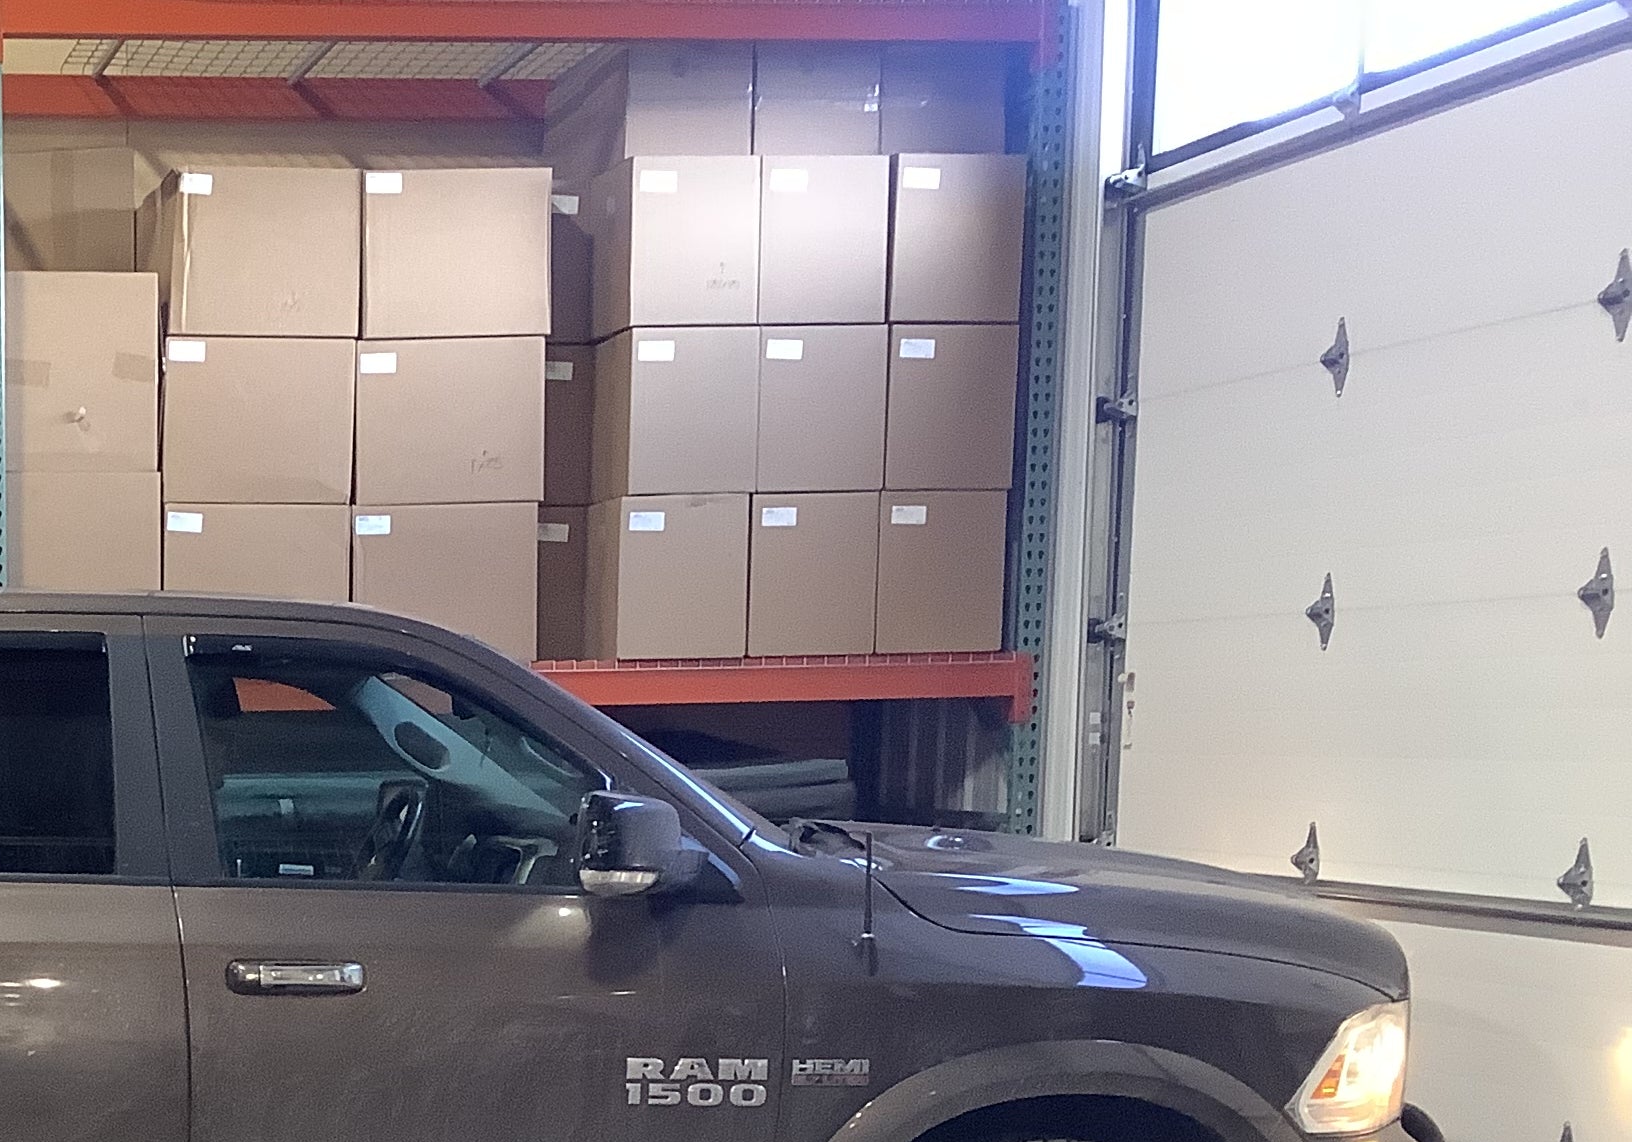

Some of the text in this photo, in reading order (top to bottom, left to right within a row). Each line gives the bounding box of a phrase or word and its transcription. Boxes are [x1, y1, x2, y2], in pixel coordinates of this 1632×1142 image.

[625, 1057, 769, 1080] RAM
[792, 1059, 869, 1075] HEMI
[625, 1082, 767, 1107] 1500
